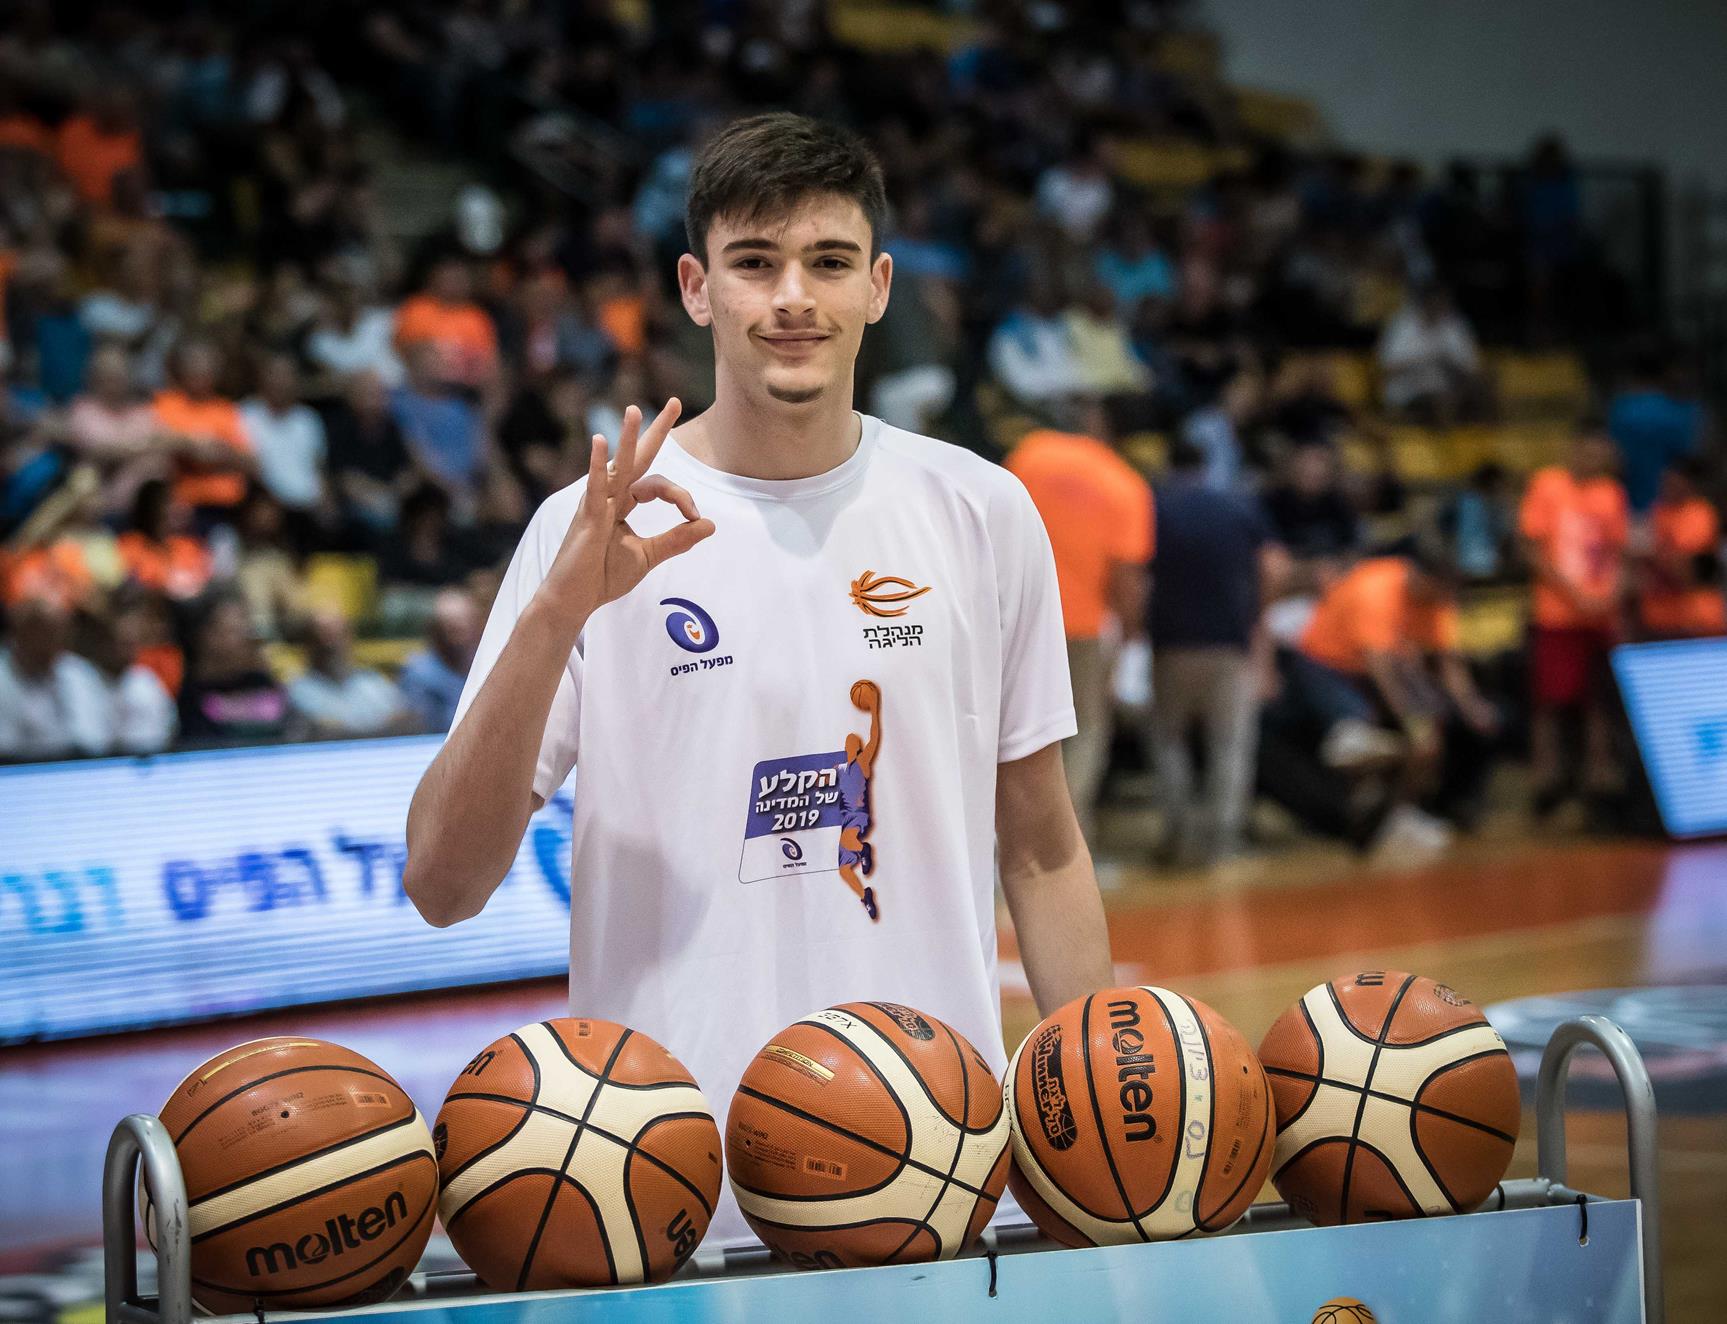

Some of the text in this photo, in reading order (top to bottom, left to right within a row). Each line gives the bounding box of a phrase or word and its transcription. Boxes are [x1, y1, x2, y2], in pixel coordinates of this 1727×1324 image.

[863, 625, 923, 639] מנהלת
[869, 635, 921, 649] הליגה
[670, 656, 733, 676] מפעל הפיס
[758, 767, 837, 798] הקלע
[756, 791, 839, 813] של המדינה
[771, 809, 820, 831] 2019
[1107, 1000, 1157, 1142] molten
[245, 1191, 408, 1277] molten
